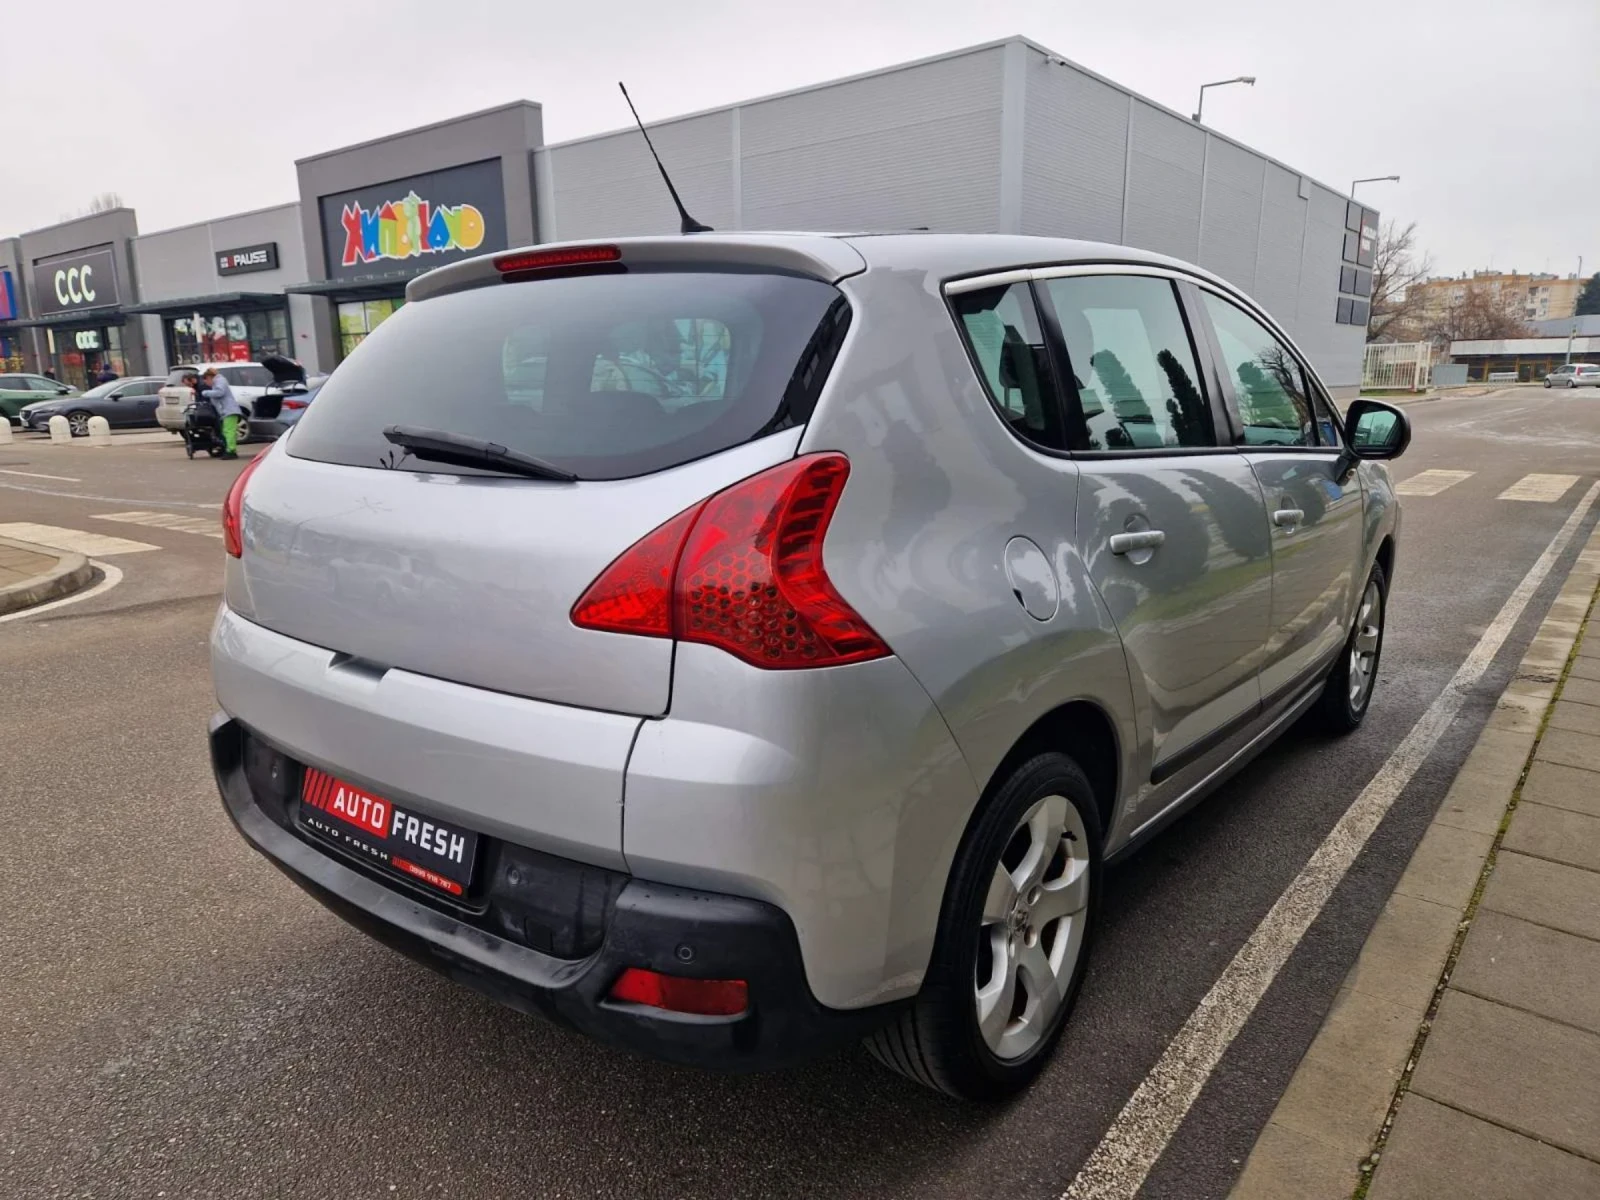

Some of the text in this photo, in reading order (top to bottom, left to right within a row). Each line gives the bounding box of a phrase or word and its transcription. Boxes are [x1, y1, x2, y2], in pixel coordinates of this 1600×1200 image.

[234, 250, 267, 266] PAUSE
[55, 265, 96, 305] CCC
[76, 330, 99, 349] CCC
[307, 817, 388, 861] AUTO FRESH
[333, 787, 465, 863] AUTO FRESH
